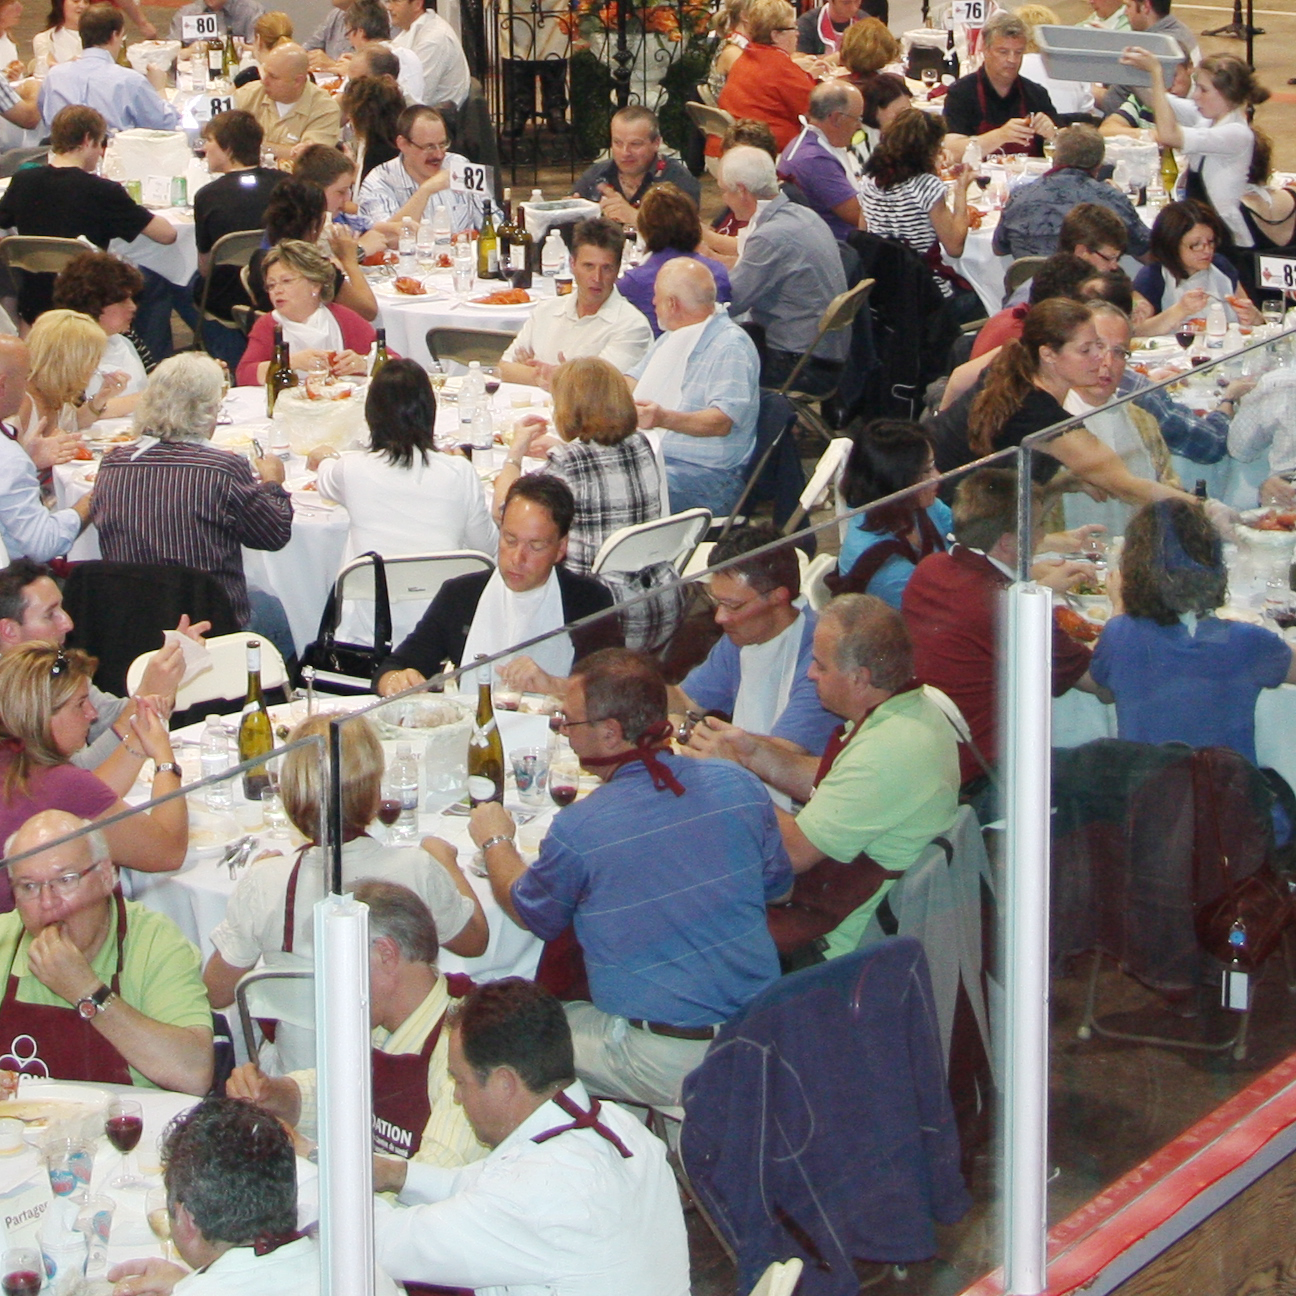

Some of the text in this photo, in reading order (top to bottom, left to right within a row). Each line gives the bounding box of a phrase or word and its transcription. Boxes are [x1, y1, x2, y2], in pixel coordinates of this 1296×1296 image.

[964, 2, 982, 19] 76
[197, 17, 215, 34] 80
[210, 97, 232, 116] 81
[464, 166, 484, 192] 82
